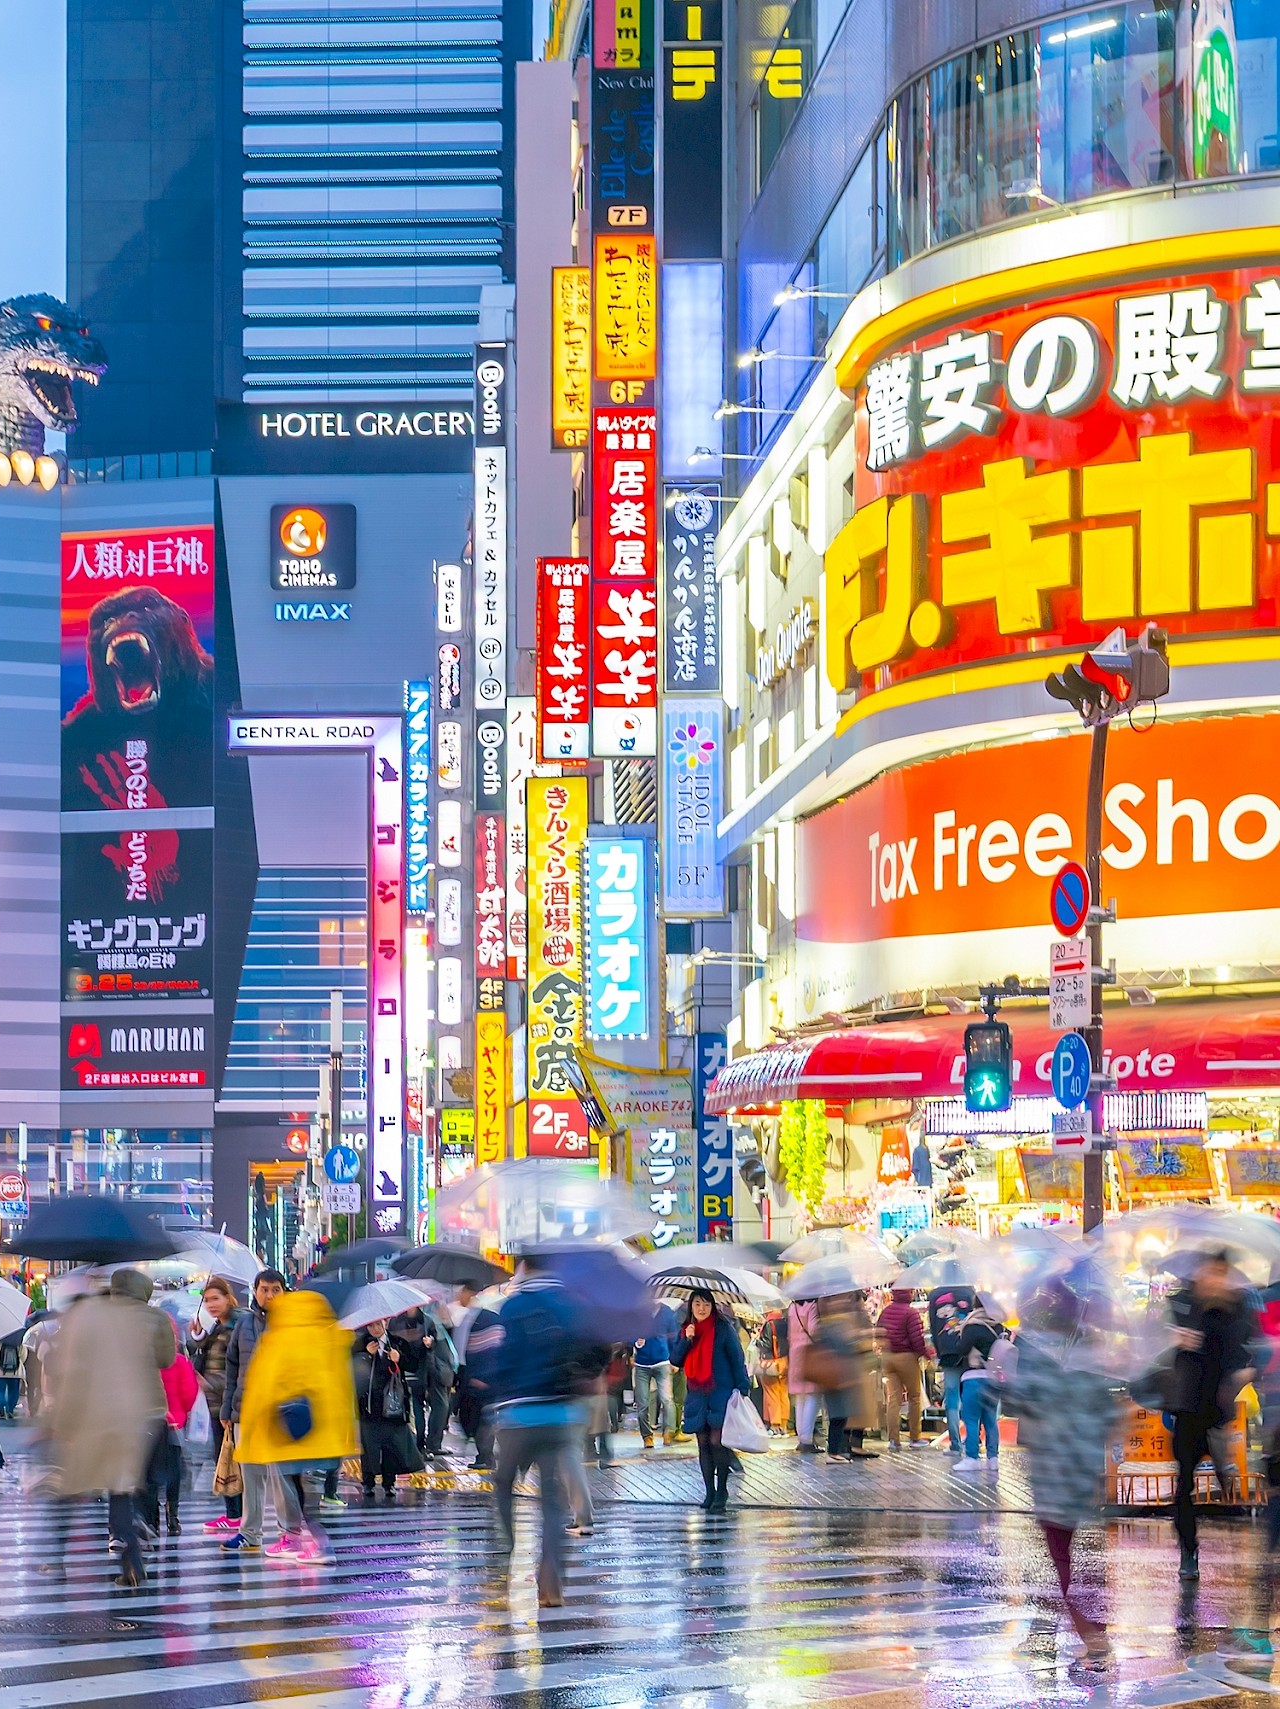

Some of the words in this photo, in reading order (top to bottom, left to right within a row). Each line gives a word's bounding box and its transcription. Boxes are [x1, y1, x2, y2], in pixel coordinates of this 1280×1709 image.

[598, 77, 624, 90] New
[601, 108, 626, 142] de
[601, 152, 626, 199] Elle
[613, 209, 643, 223] 7F
[477, 360, 505, 436] Booth
[609, 381, 645, 404] 6F
[261, 411, 351, 438] HOTEL
[563, 429, 588, 447] 6F
[484, 457, 498, 540] ネットカフェ
[608, 460, 647, 576] 居楽屋
[66, 536, 209, 581] 人類対巨神。
[280, 559, 321, 575] TOHO
[484, 548, 497, 562] &
[279, 574, 338, 587] CINEMAS
[483, 570, 498, 626] カプセル
[275, 603, 351, 621] IMAX
[556, 588, 577, 642] 居楽屋
[673, 533, 699, 682] かんかん商店
[596, 588, 657, 705] 笑笑
[757, 645, 775, 692] Don
[776, 600, 812, 663] Quijote
[236, 725, 320, 740] CENTRAL
[326, 724, 375, 740] ROAD
[126, 740, 148, 809] 勝つのは
[477, 721, 505, 796] Booth
[678, 775, 694, 843] STAGE
[695, 775, 710, 832] IDOL
[126, 832, 148, 901] どっちだ
[543, 786, 572, 933] きんくら酒場
[678, 863, 709, 887] 5F
[868, 831, 919, 906] Tax
[932, 811, 1073, 890] Free
[67, 912, 207, 950] キングコング
[475, 885, 506, 968] 甘太郎
[594, 844, 642, 1029] カラオケ
[76, 973, 133, 991] 3.25
[376, 823, 400, 1133] ゴジラロード
[479, 977, 504, 995] 4F
[479, 994, 505, 1010] 3F
[110, 1026, 205, 1053] MARUHAN
[533, 971, 581, 1093] 金の蔵
[1058, 1051, 1074, 1099] P
[1070, 1077, 1082, 1097] 40
[532, 1103, 570, 1134] 2F
[608, 1101, 668, 1113] KARAOKE
[671, 1100, 692, 1111] 747
[648, 1127, 680, 1248] カラオケ
